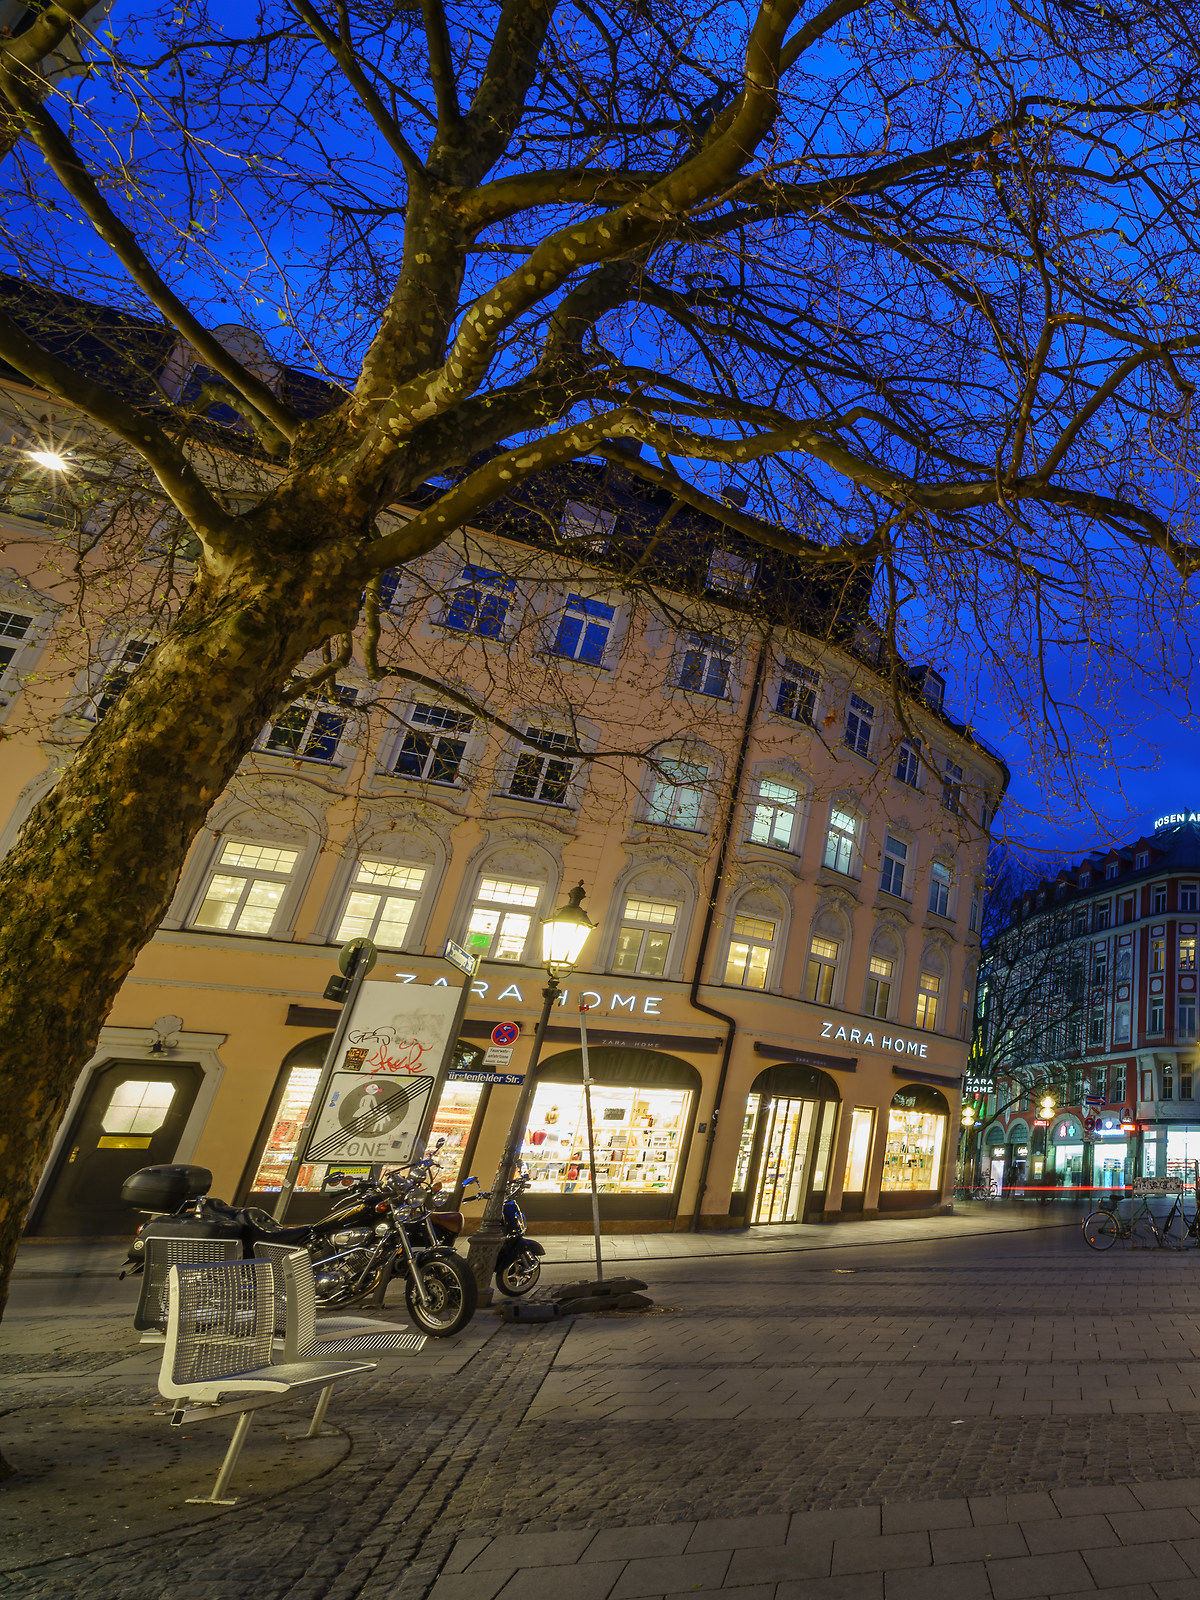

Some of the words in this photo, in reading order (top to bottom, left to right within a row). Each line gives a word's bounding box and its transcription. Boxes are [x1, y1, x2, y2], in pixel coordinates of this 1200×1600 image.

[1154, 813, 1185, 829] ROSEN
[820, 1022, 875, 1047] ZARA
[881, 1035, 928, 1058] HOME
[448, 1071, 503, 1083] ürtenfelder
[505, 1075, 520, 1083] Str.
[333, 1142, 389, 1157] ZONE
